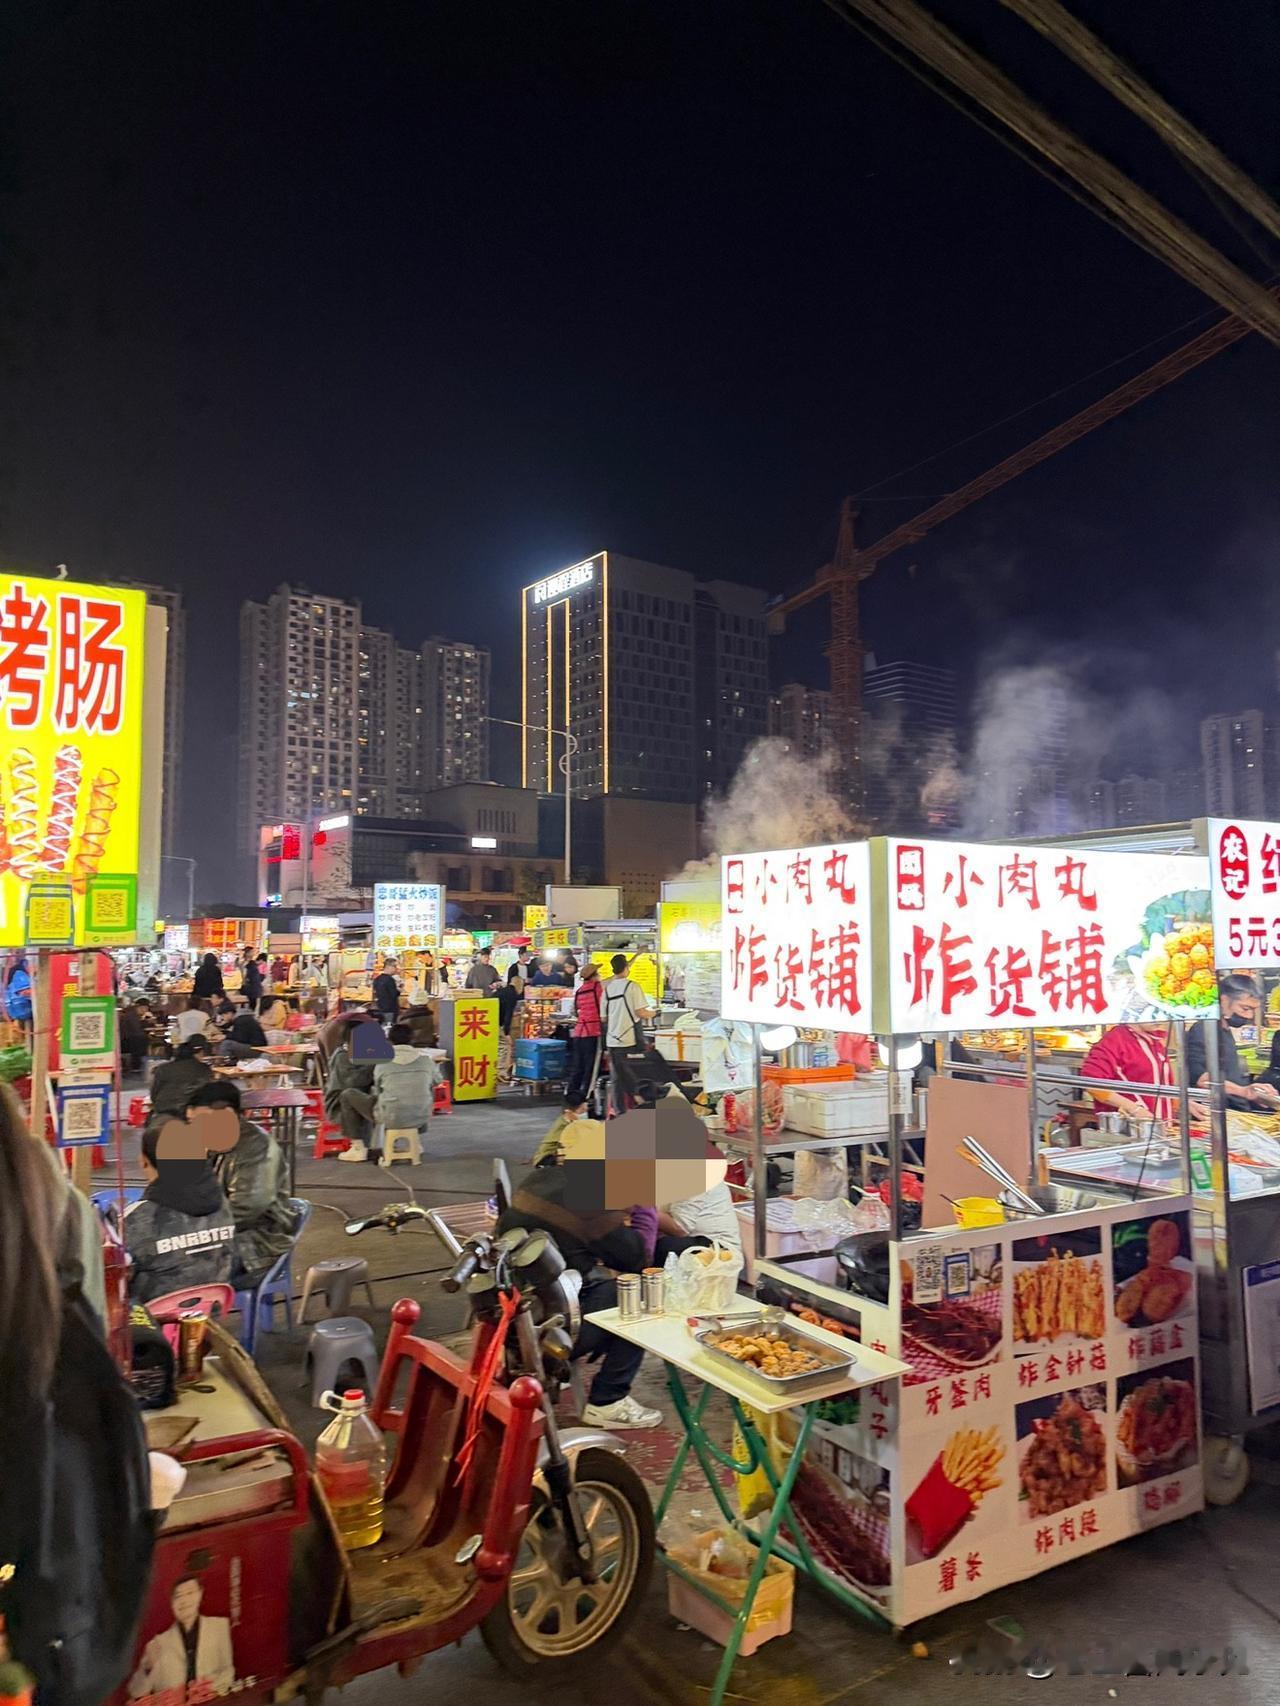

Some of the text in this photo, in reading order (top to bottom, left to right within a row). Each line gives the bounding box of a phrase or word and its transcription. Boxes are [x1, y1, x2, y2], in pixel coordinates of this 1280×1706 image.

[0, 586, 124, 731] 烤肠
[755, 850, 855, 905] 小肉丸
[943, 853, 1098, 911] 小肉丸
[730, 920, 862, 1016] 炸货铺
[903, 921, 1109, 1017] 炸货铺
[458, 1006, 490, 1088] 来财
[926, 1372, 991, 1416] 牙签肉
[1018, 1343, 1107, 1388] 炸金针菇
[937, 1551, 983, 1593] 薯条
